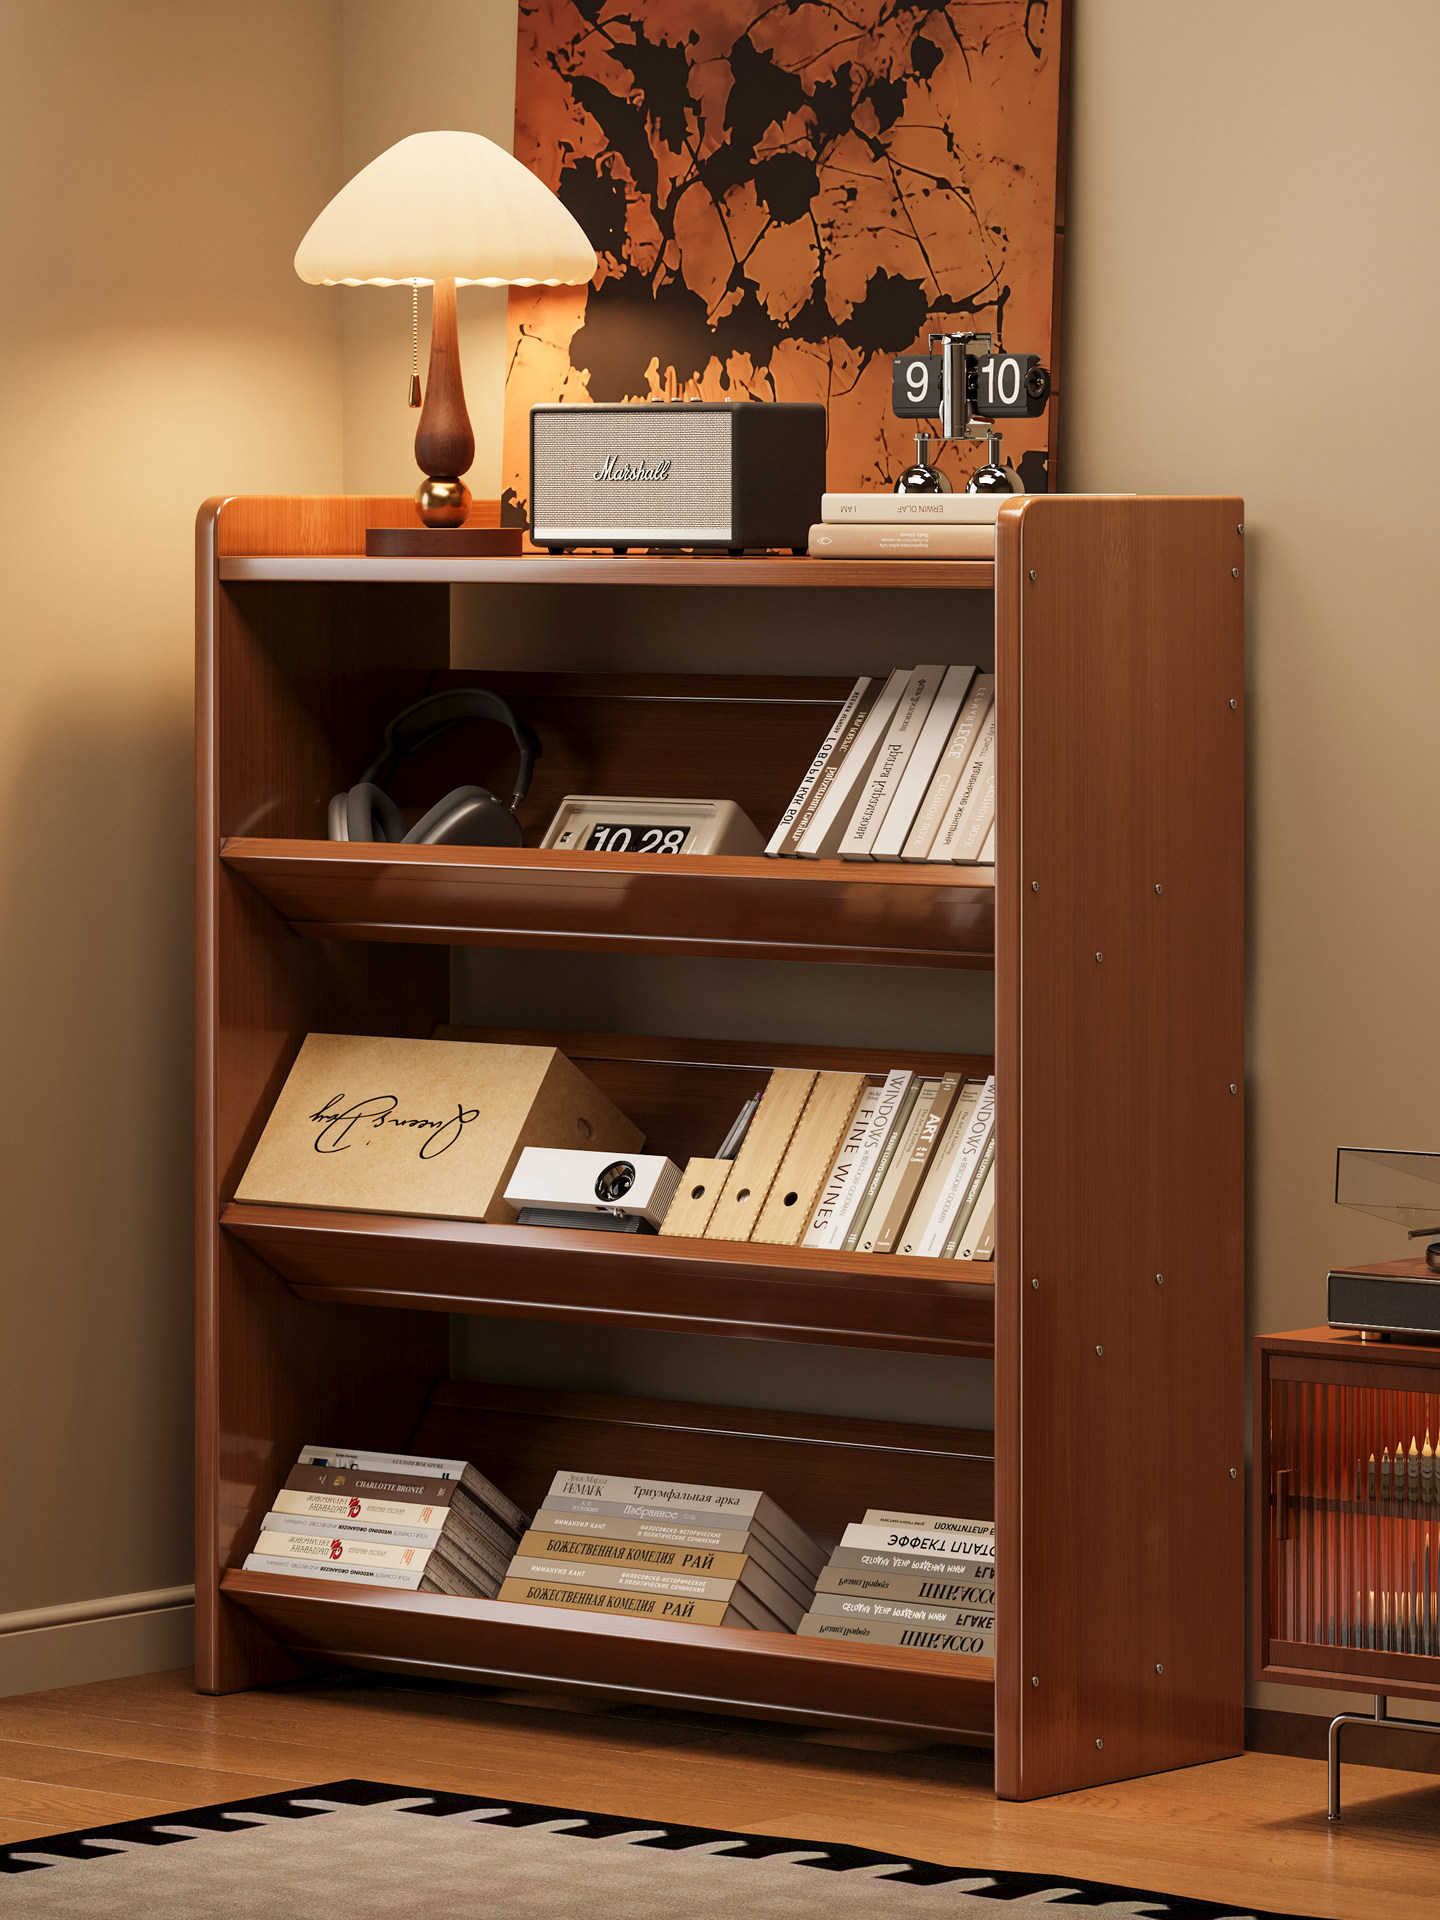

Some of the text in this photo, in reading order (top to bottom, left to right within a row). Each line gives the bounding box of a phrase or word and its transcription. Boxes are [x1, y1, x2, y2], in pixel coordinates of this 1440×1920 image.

[906, 358, 1020, 404] 9 10
[593, 454, 672, 482] Marshall
[897, 505, 917, 513] OLAF
[310, 1094, 398, 1153] Day
[864, 1076, 905, 1148] WINDOWS
[844, 1110, 874, 1152] FINE
[919, 1113, 941, 1142] ART
[853, 1156, 869, 1185] BERGDORF
[866, 1132, 898, 1197] FRANK LLOYD WRIGHT
[951, 1163, 967, 1191] BERGDORF
[966, 1139, 994, 1204] FRANK LLOYD WRIGHT
[814, 1164, 852, 1228] WINES
[840, 1186, 856, 1216] GOODMAN
[938, 1193, 954, 1223] GOODMAN
[356, 1481, 396, 1492] CHARLOTTE
[634, 1486, 740, 1507] Триумфальная арка
[624, 1505, 678, 1519] Избранное
[640, 1525, 721, 1538] ФИЛОСОФСКО-ИСТОРИЧЕСКИЕ
[643, 1532, 685, 1541] ПОЛИТИЧЕСКИЕ
[547, 1540, 714, 1569] БОЖЕСТВЕННАЯ КОМЕДИЯ РАЙ
[531, 1566, 567, 1575] ИММАНУИЛ
[621, 1573, 706, 1585] ФИЛОСОФСКО-ИСТОРИЧЕСКИЕ
[625, 1580, 668, 1589] ПОЛИТИЧЕСКИЕ
[671, 1585, 704, 1593] СОЧИНЕНИЯ
[527, 1587, 694, 1617] БОЖЕСТВЕННАЯ КОМЕДИЯ РАЙ
